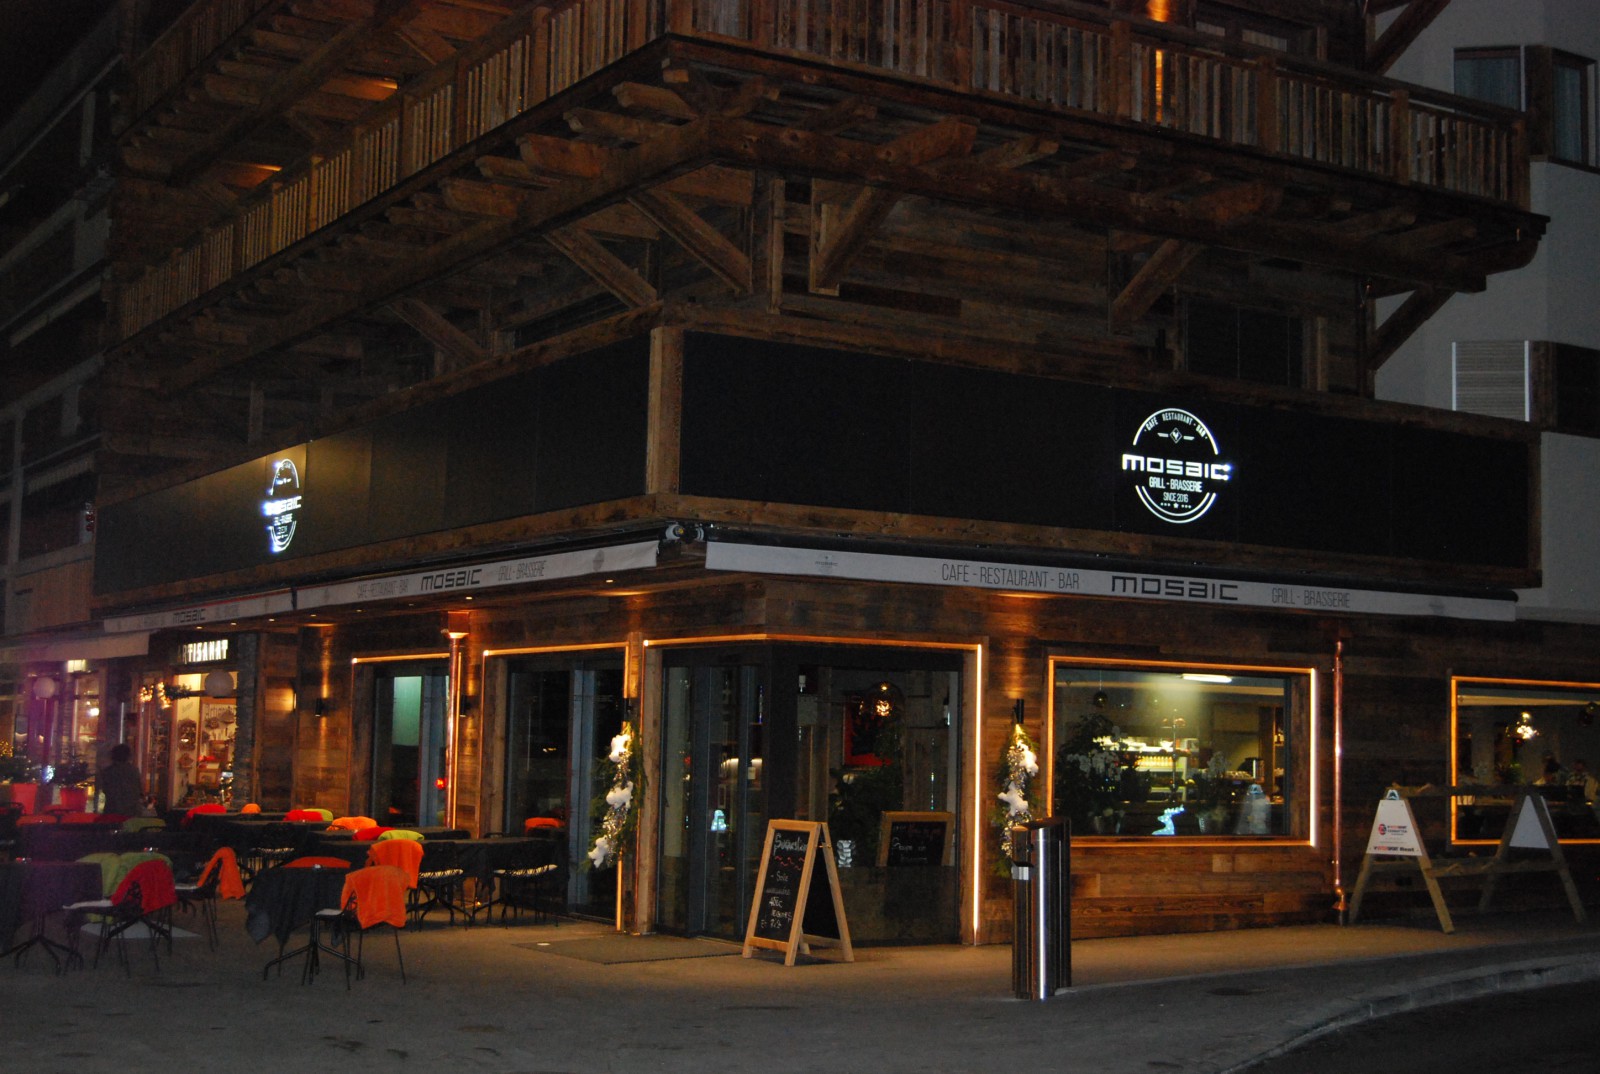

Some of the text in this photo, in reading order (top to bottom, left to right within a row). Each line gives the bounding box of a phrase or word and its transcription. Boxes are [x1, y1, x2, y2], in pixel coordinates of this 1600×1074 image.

[1122, 453, 1231, 480] mosaic
[1149, 476, 1202, 493] GRILL BRASSERIE
[1163, 492, 1176, 501] SINCE
[420, 569, 482, 591] mosaic
[979, 566, 1050, 589] RESTAURANT
[1058, 573, 1080, 590] BAR
[1111, 575, 1239, 601] mosaic
[1271, 587, 1295, 606] GRILL
[1304, 589, 1350, 609] BRASSERIE
